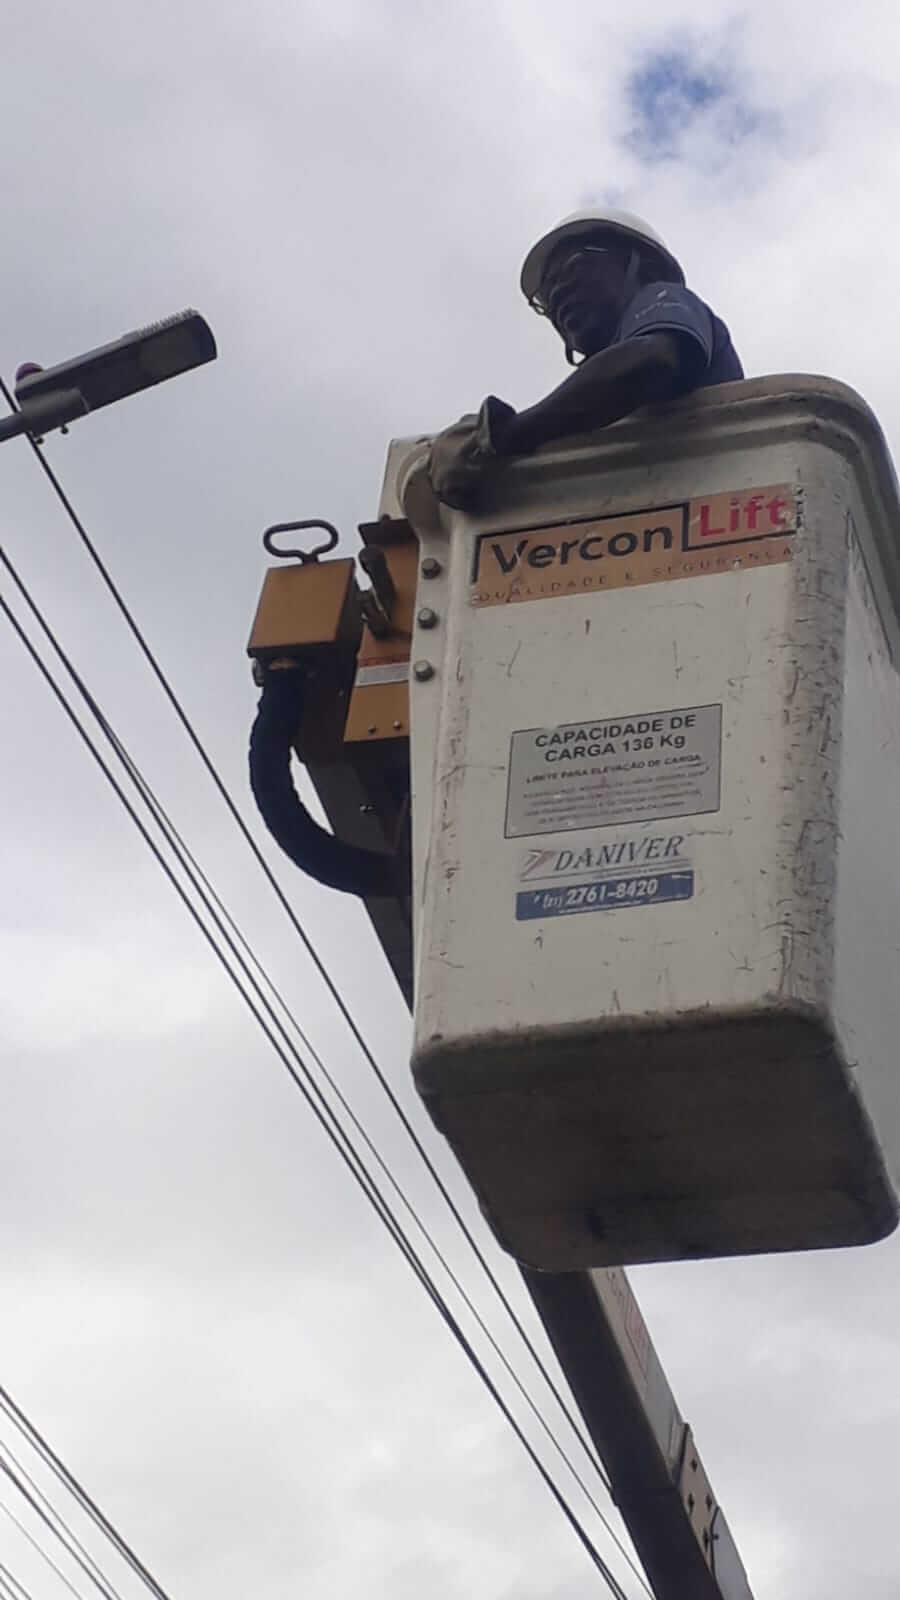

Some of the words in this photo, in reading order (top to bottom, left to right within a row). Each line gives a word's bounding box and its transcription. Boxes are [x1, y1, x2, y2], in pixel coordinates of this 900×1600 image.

[491, 524, 673, 573] Vercon
[699, 495, 787, 537] Lift
[536, 718, 663, 748] CAPACIDADE
[670, 714, 697, 729] DE
[545, 742, 616, 763] CARGA
[621, 736, 654, 753] 136
[660, 733, 686, 749] Kg
[648, 759, 661, 768] DE
[664, 754, 701, 765] CARGA
[554, 835, 684, 872] DANIVER
[567, 878, 659, 905] 2761-8420
